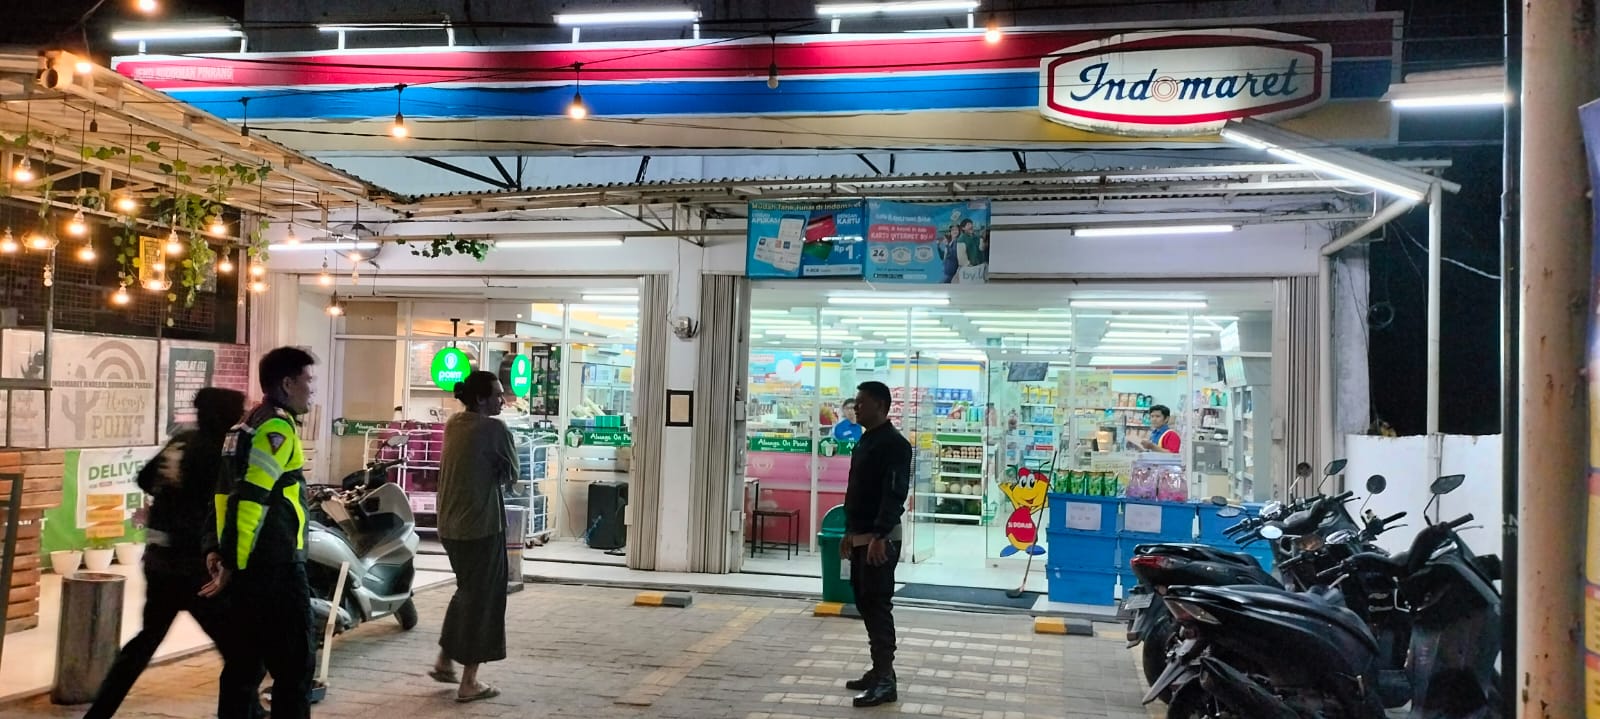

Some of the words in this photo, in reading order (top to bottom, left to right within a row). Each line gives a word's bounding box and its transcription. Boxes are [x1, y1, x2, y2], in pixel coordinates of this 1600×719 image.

[1070, 59, 1298, 102] Indomaret
[834, 245, 845, 253] Rp
[91, 415, 145, 439] POINT
[590, 433, 612, 442] Always
[613, 433, 622, 441] On
[758, 439, 780, 448] Always
[782, 439, 791, 447] On
[792, 440, 809, 448] Point
[88, 460, 146, 481] DELIVE
